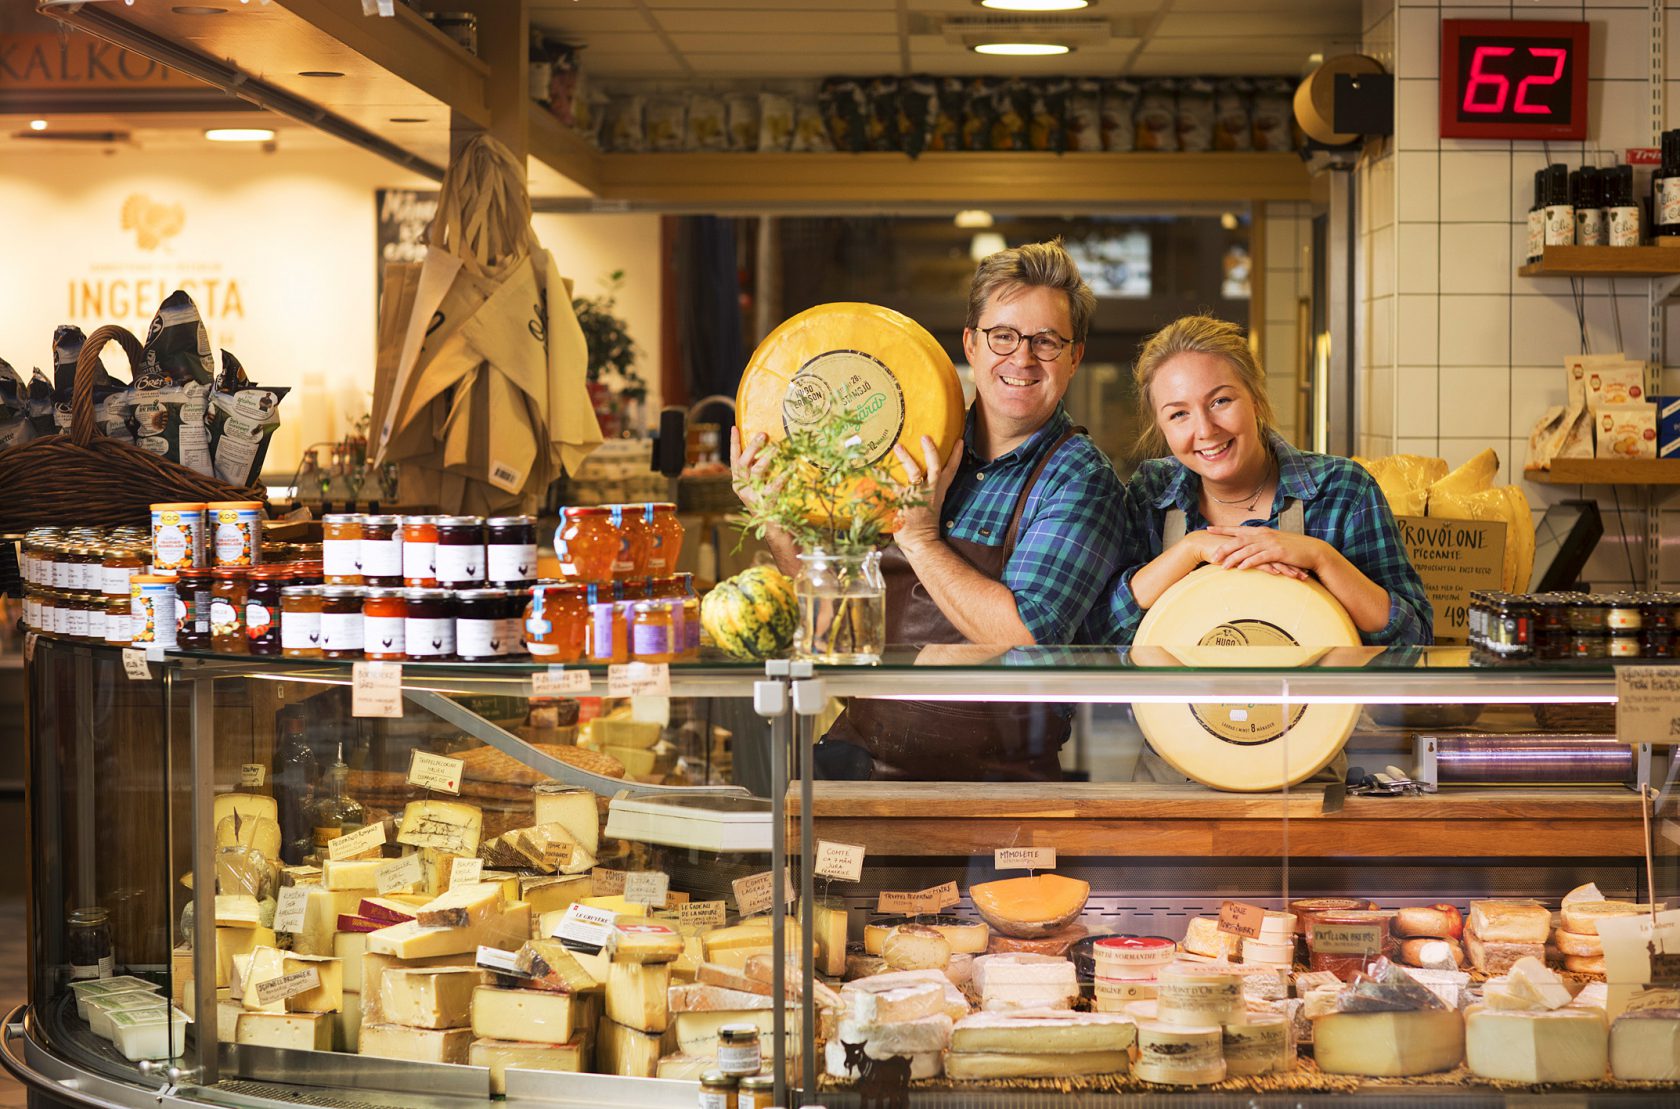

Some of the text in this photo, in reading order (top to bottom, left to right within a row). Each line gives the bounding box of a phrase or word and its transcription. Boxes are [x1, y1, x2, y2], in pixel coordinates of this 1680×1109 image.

[1463, 46, 1567, 114] 62
[867, 441, 878, 451] 12
[1397, 519, 1488, 549] PROVOLONE
[1413, 547, 1462, 560] PICCANTE
[1250, 723, 1256, 733] 8
[1000, 850, 1040, 859] MIMOLETTE
